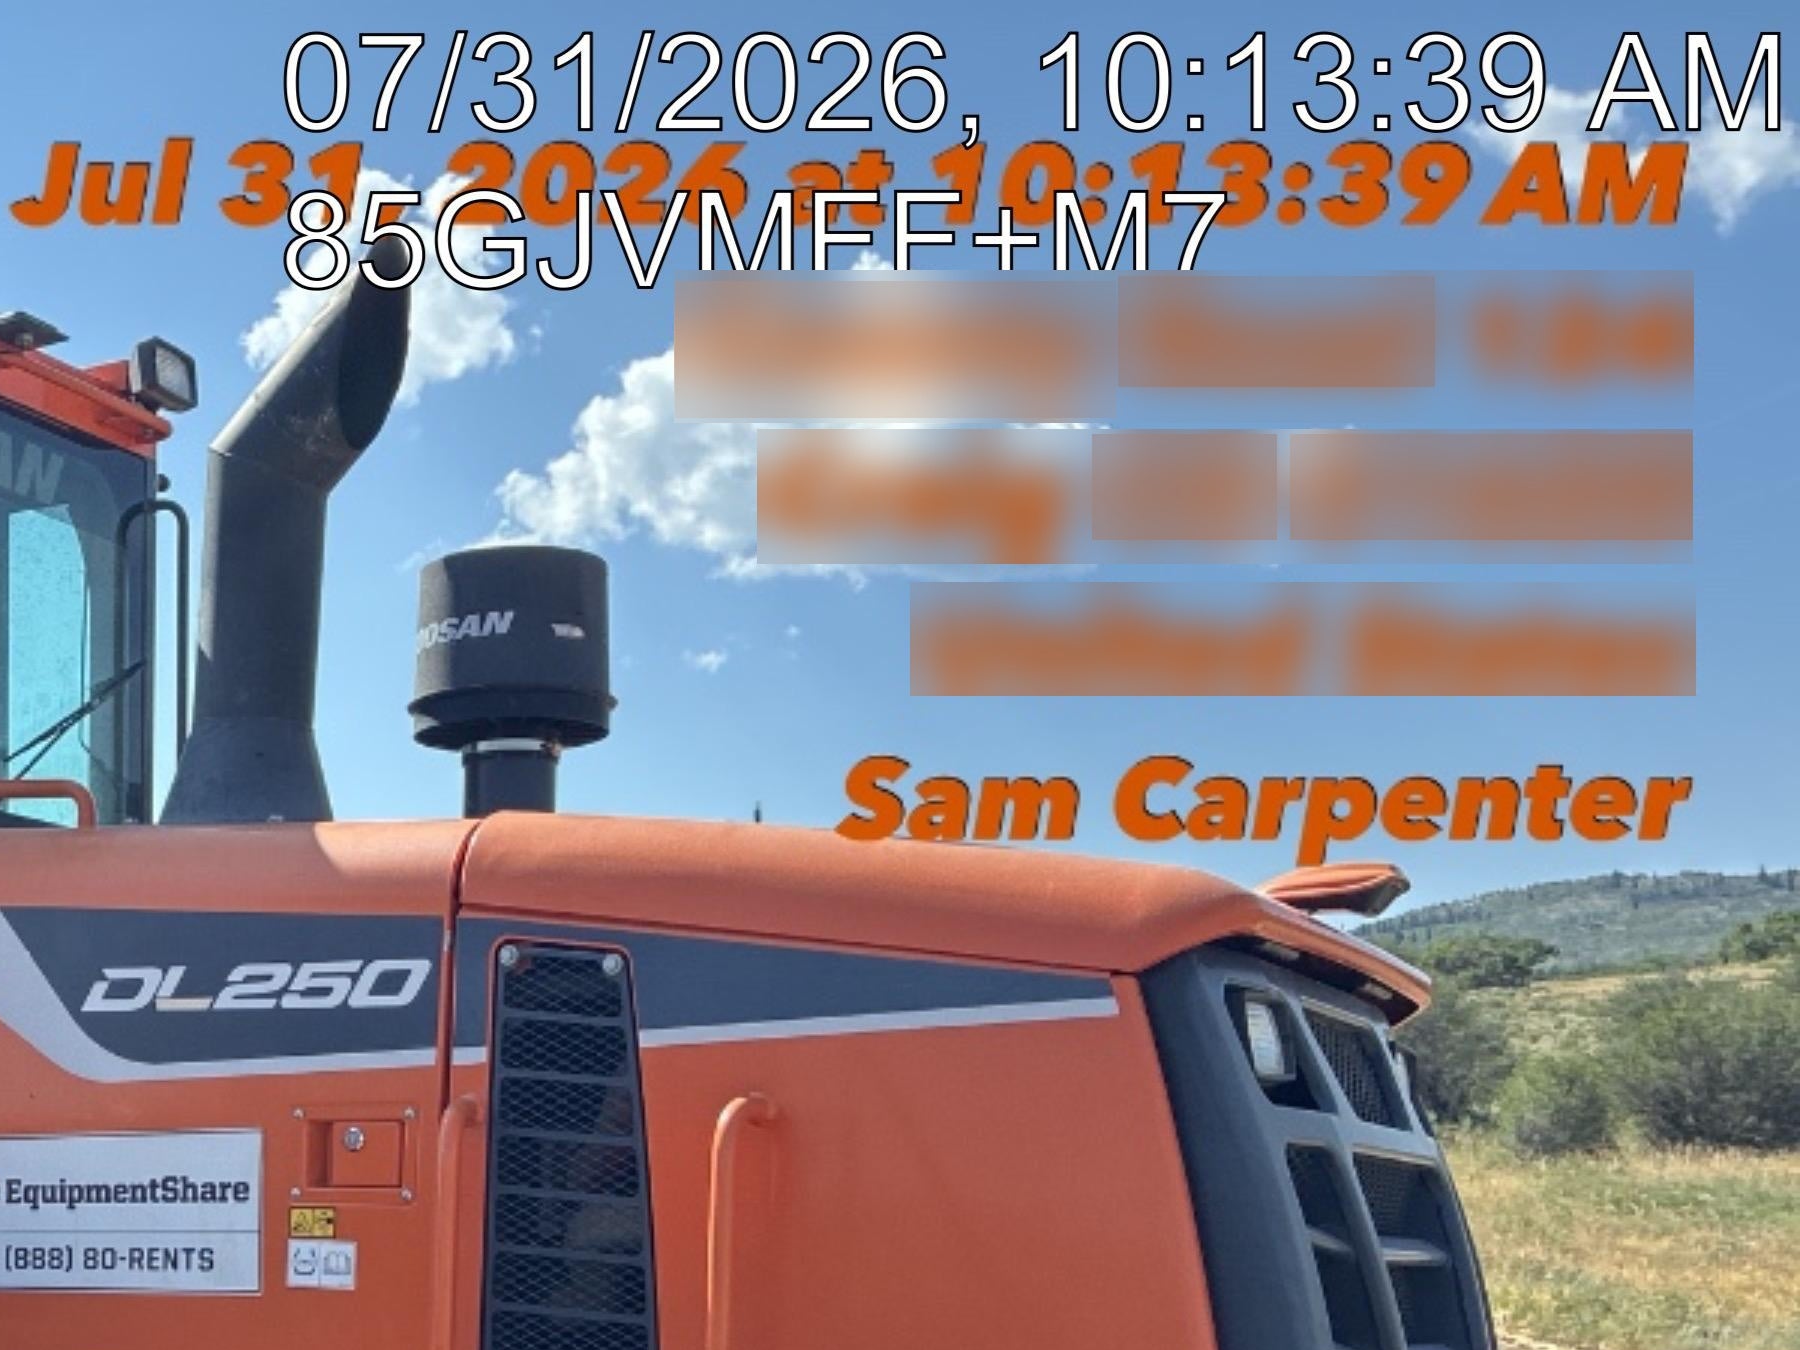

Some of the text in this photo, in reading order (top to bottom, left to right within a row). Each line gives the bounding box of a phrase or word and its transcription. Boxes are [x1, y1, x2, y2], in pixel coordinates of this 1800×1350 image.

[80, 958, 433, 1013] DL250
[4, 1175, 251, 1211] EquipmentShare
[4, 1244, 215, 1273] (888) 80-RENTS
